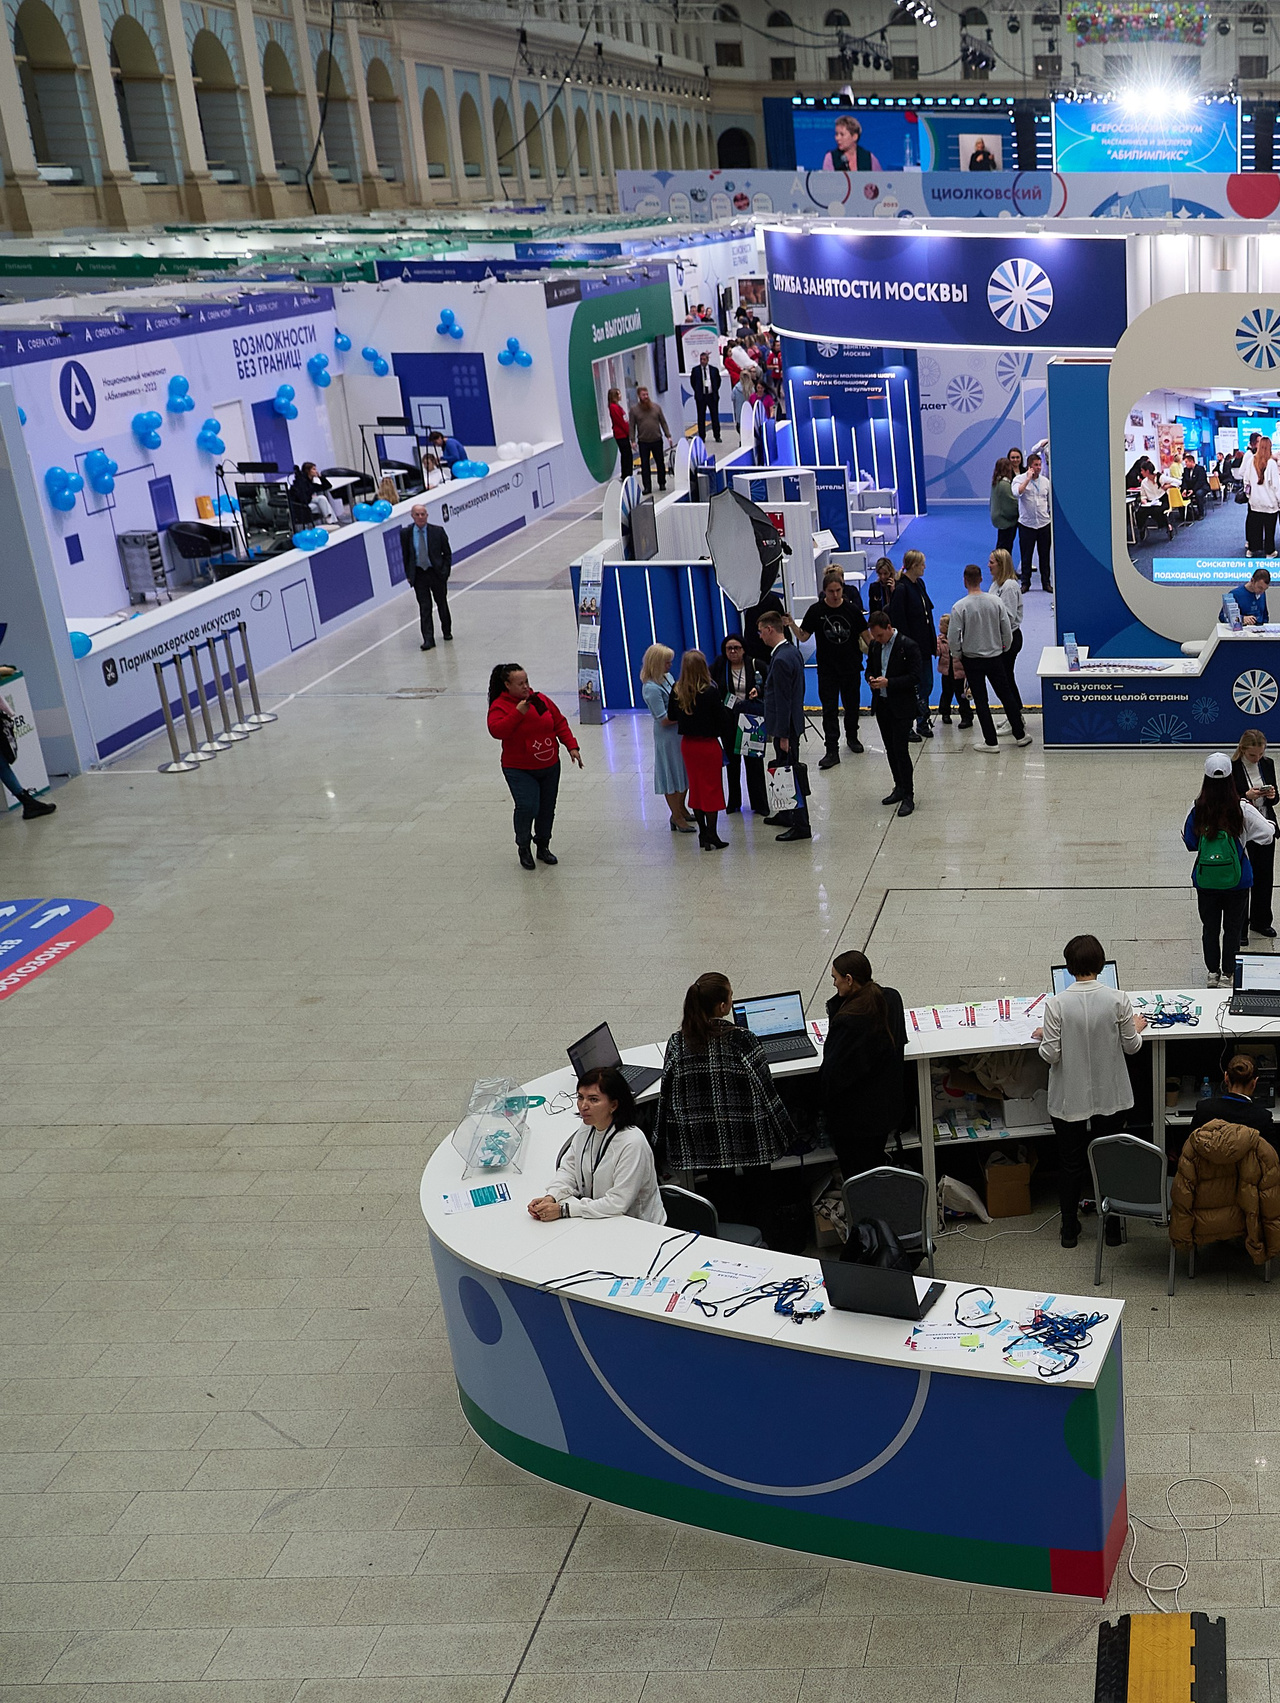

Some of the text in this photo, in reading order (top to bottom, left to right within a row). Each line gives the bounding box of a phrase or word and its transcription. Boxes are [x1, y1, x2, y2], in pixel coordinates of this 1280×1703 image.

[931, 186, 1042, 201] ЦИОЛКОВСКИЙ
[772, 273, 967, 303] СЛУЖБА ЗАНЯТОСТИ МОСКВЫ
[604, 308, 642, 339] ВЫГОТСКИЙ
[233, 325, 317, 358] ВОЗМОЖНОСТИ
[236, 350, 303, 380] БЕЗ ГРАНИЦ!
[1196, 559, 1246, 568] Соискатели
[1154, 571, 1211, 580] подходящую
[119, 608, 241, 674] Парикмахерское искусство
[1054, 683, 1079, 691] Твой
[1081, 684, 1112, 692] успех
[1082, 694, 1113, 703] успех
[1114, 693, 1147, 702] целой
[1149, 694, 1188, 703] страны
